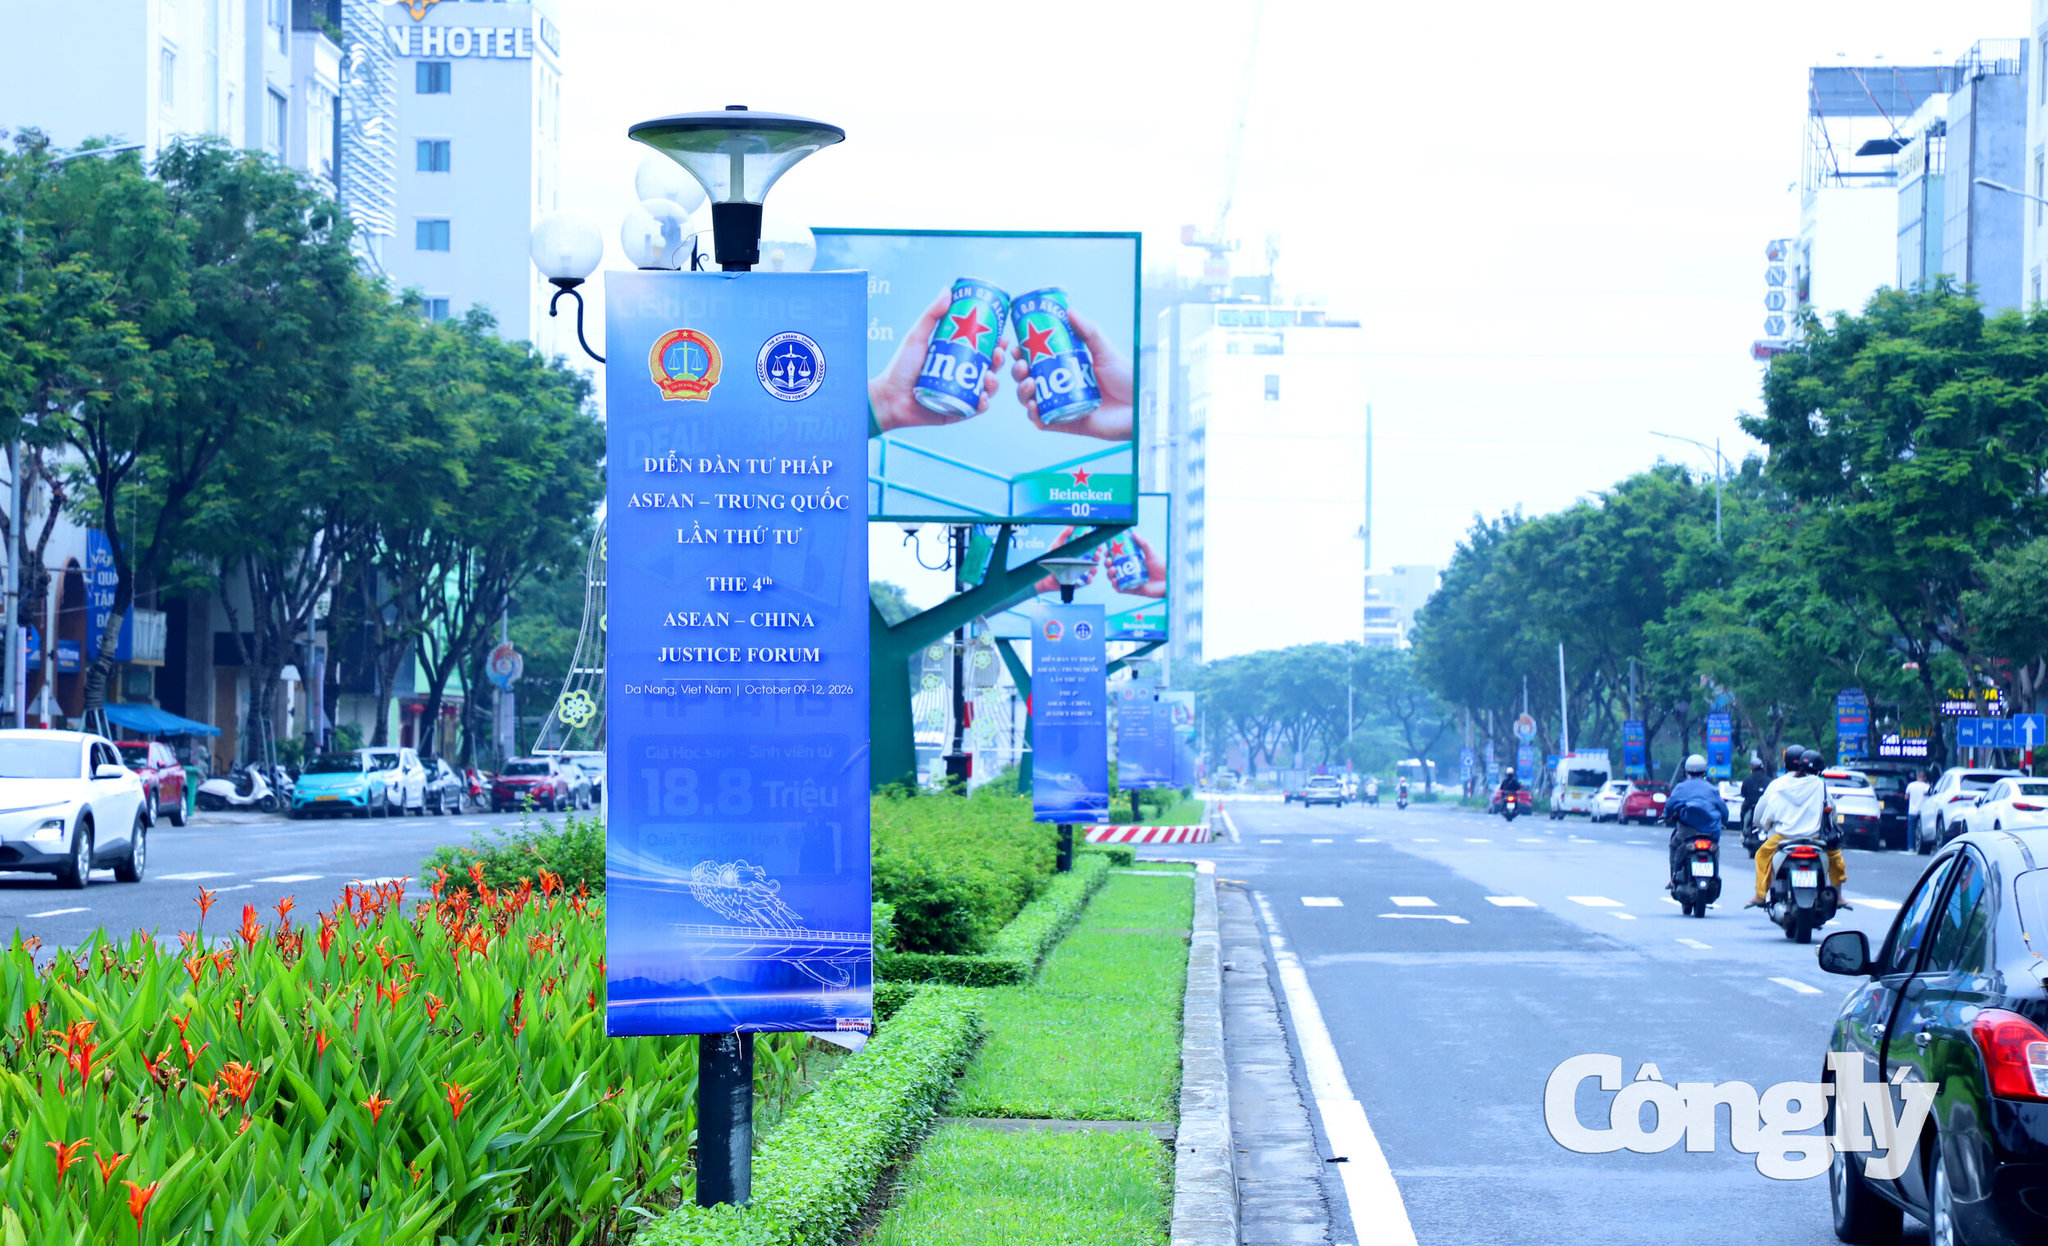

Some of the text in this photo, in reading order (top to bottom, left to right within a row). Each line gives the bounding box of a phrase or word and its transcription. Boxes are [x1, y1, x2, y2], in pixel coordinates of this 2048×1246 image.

[421, 26, 532, 58] HOTEL
[644, 450, 833, 475] DIỄN ĐÀN TƯ PHÁP
[627, 493, 695, 508] ASEAN
[715, 494, 785, 509] TRUNG
[790, 486, 849, 512] QUỐC
[1049, 487, 1112, 501] Heineken
[677, 520, 803, 545] LẦN THỨ TƯ
[706, 575, 773, 592] THE 4th
[663, 611, 730, 627] ASEAN
[750, 612, 815, 628] CHINA
[657, 647, 820, 663] JUSTICE FORUM
[625, 684, 642, 695] Da
[644, 684, 678, 697] Nang,
[680, 684, 702, 695] Viet
[705, 684, 732, 695] Nam
[745, 684, 791, 695] October
[793, 685, 825, 697] 09-12,
[828, 685, 854, 695] 2026
